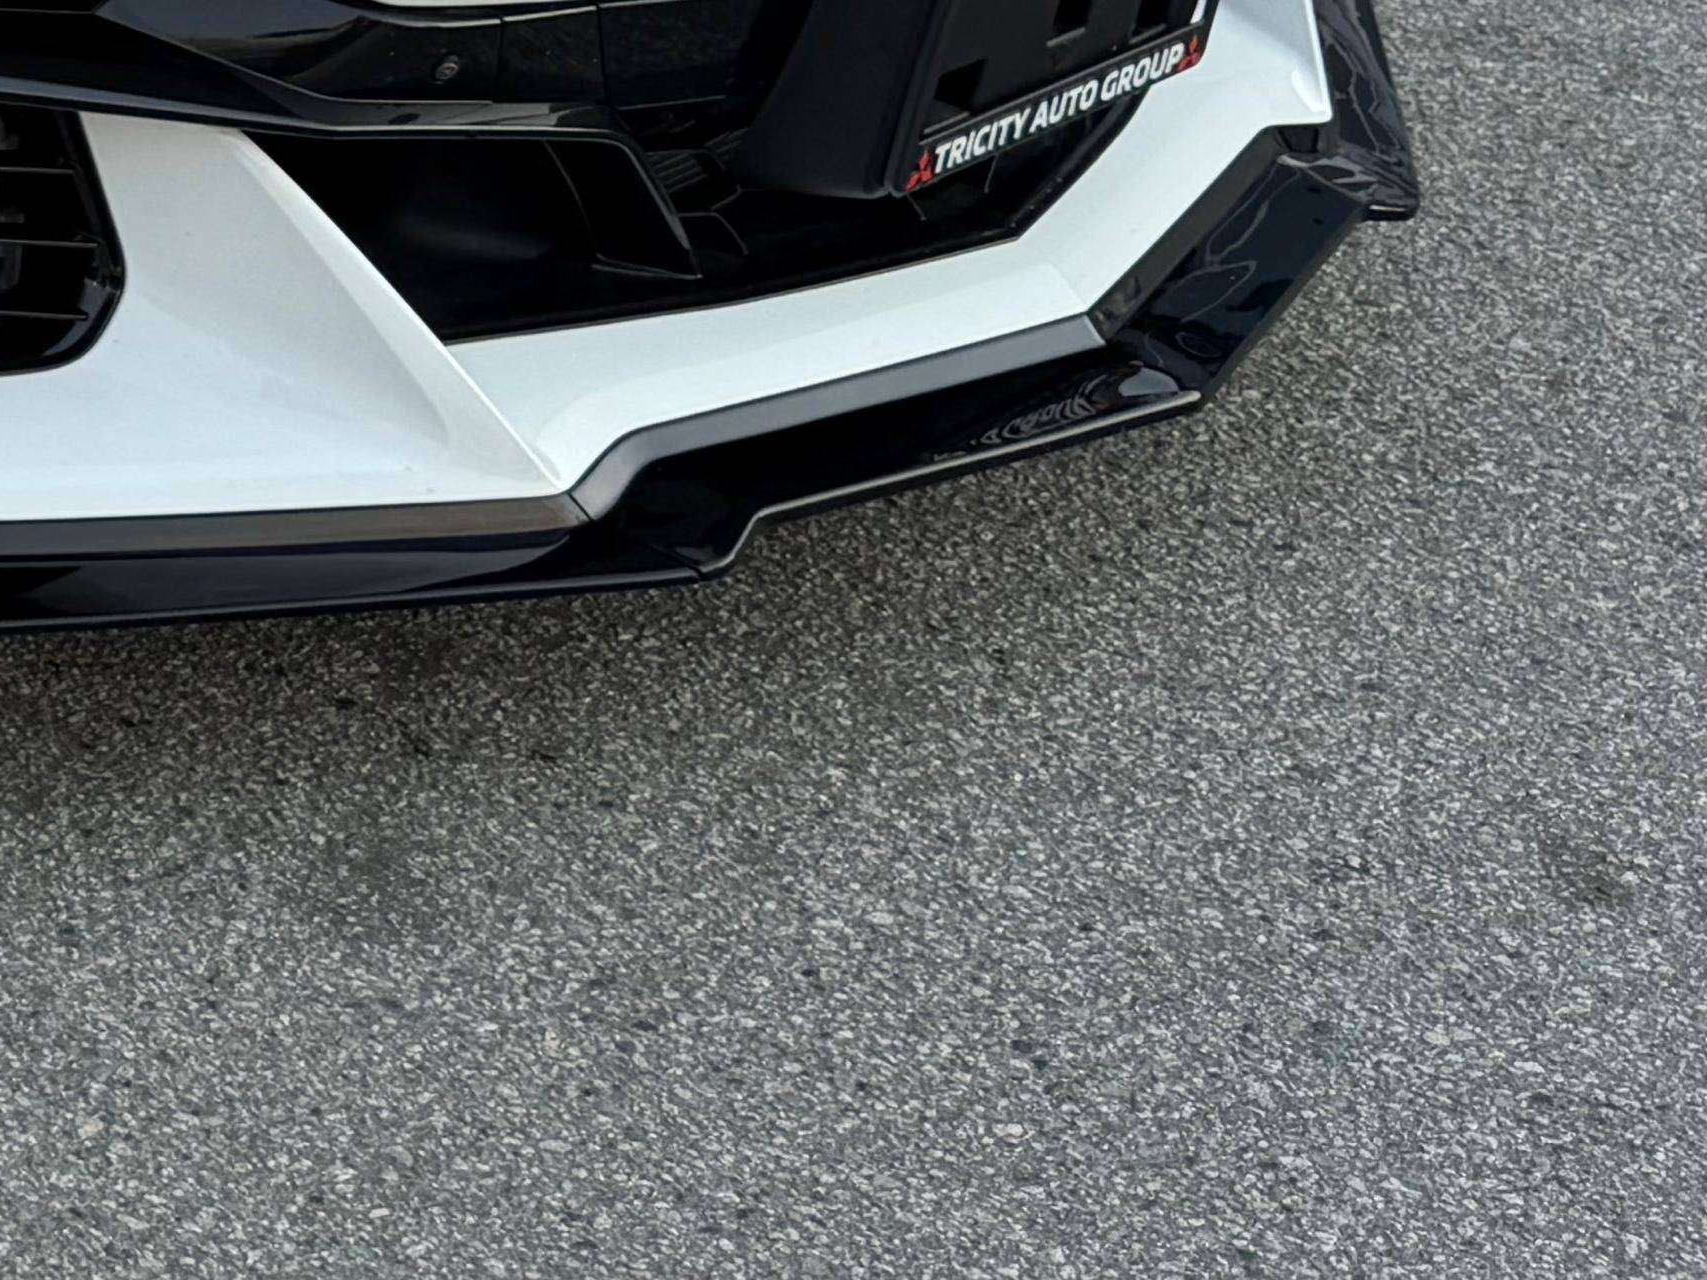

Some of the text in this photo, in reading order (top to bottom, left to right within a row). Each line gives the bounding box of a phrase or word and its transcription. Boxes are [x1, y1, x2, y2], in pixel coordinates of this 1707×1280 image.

[934, 42, 1185, 174] TRICITY AUTO GROUP
